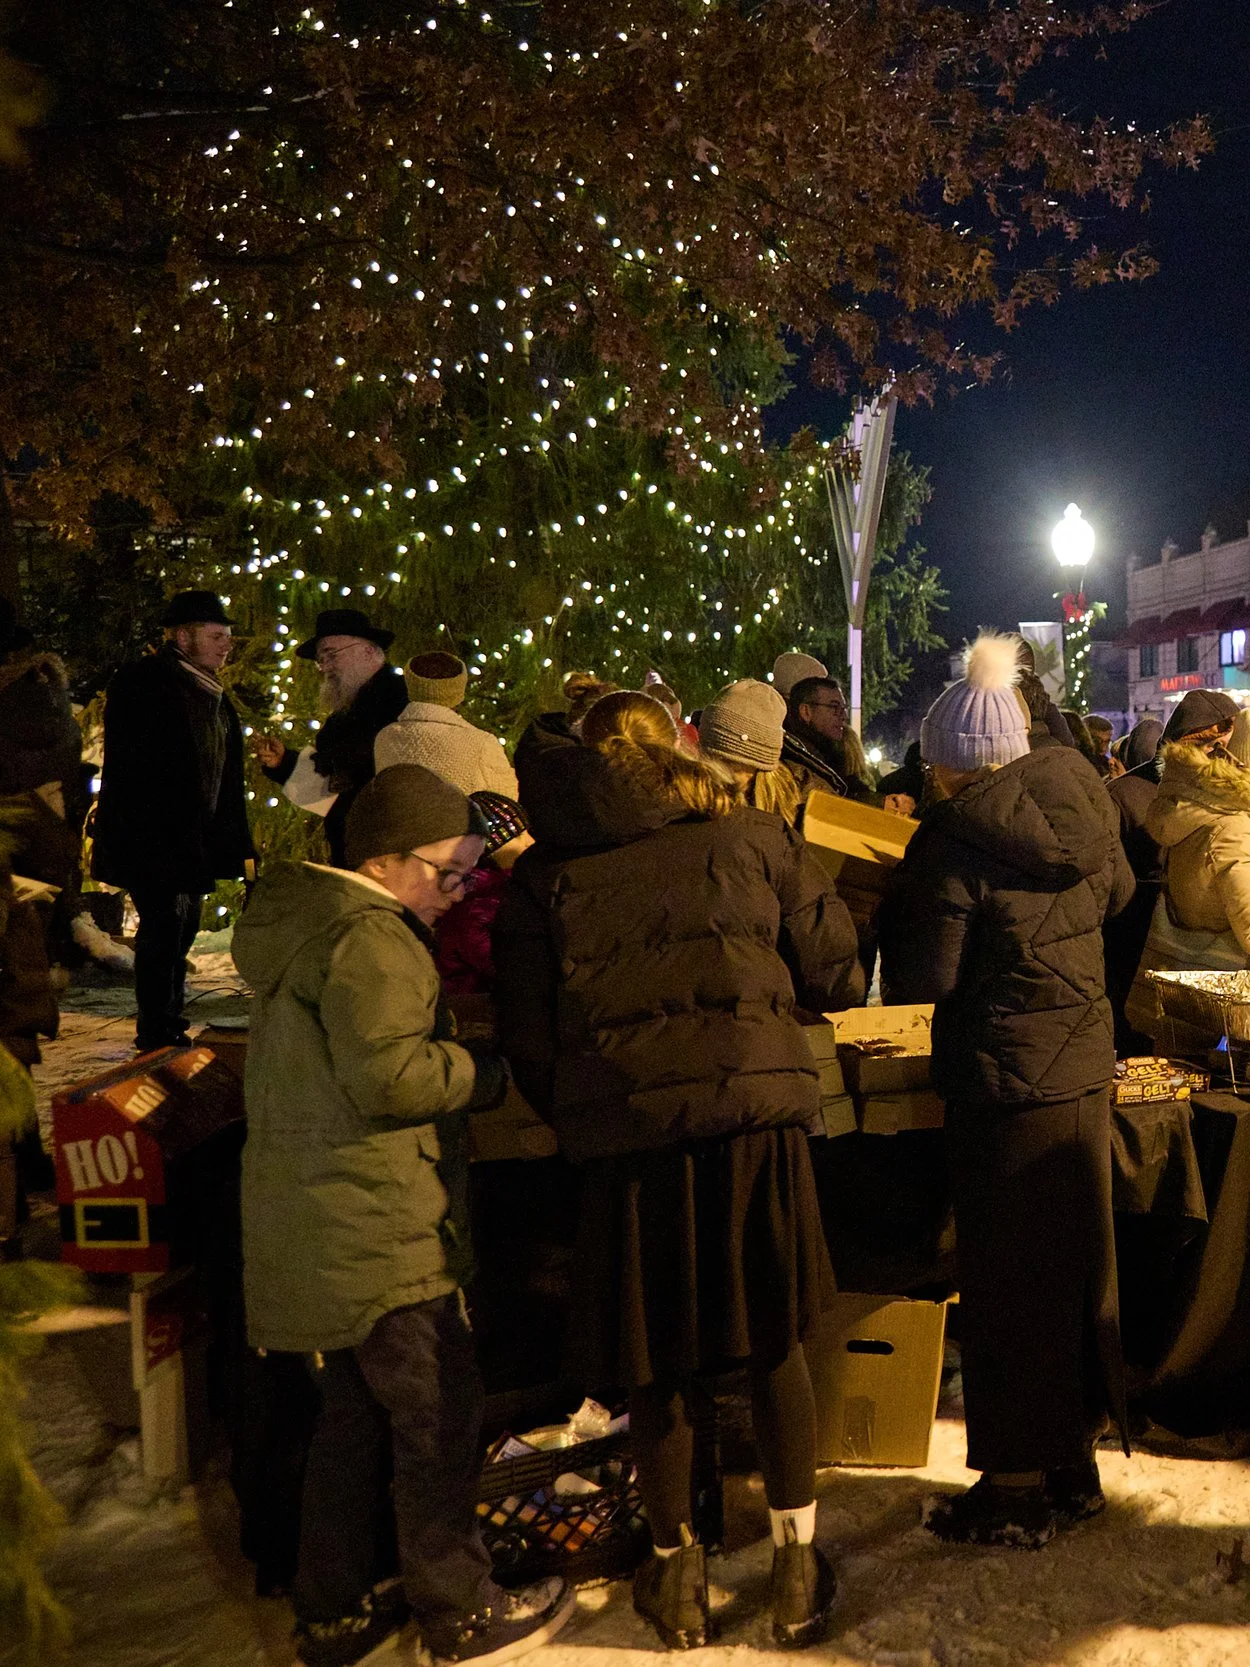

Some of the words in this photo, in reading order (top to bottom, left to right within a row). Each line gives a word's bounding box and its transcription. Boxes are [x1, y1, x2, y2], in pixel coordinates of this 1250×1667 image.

[1126, 1063, 1163, 1077] GELT
[1143, 1081, 1172, 1097] GELT
[61, 1130, 145, 1192] HO!
